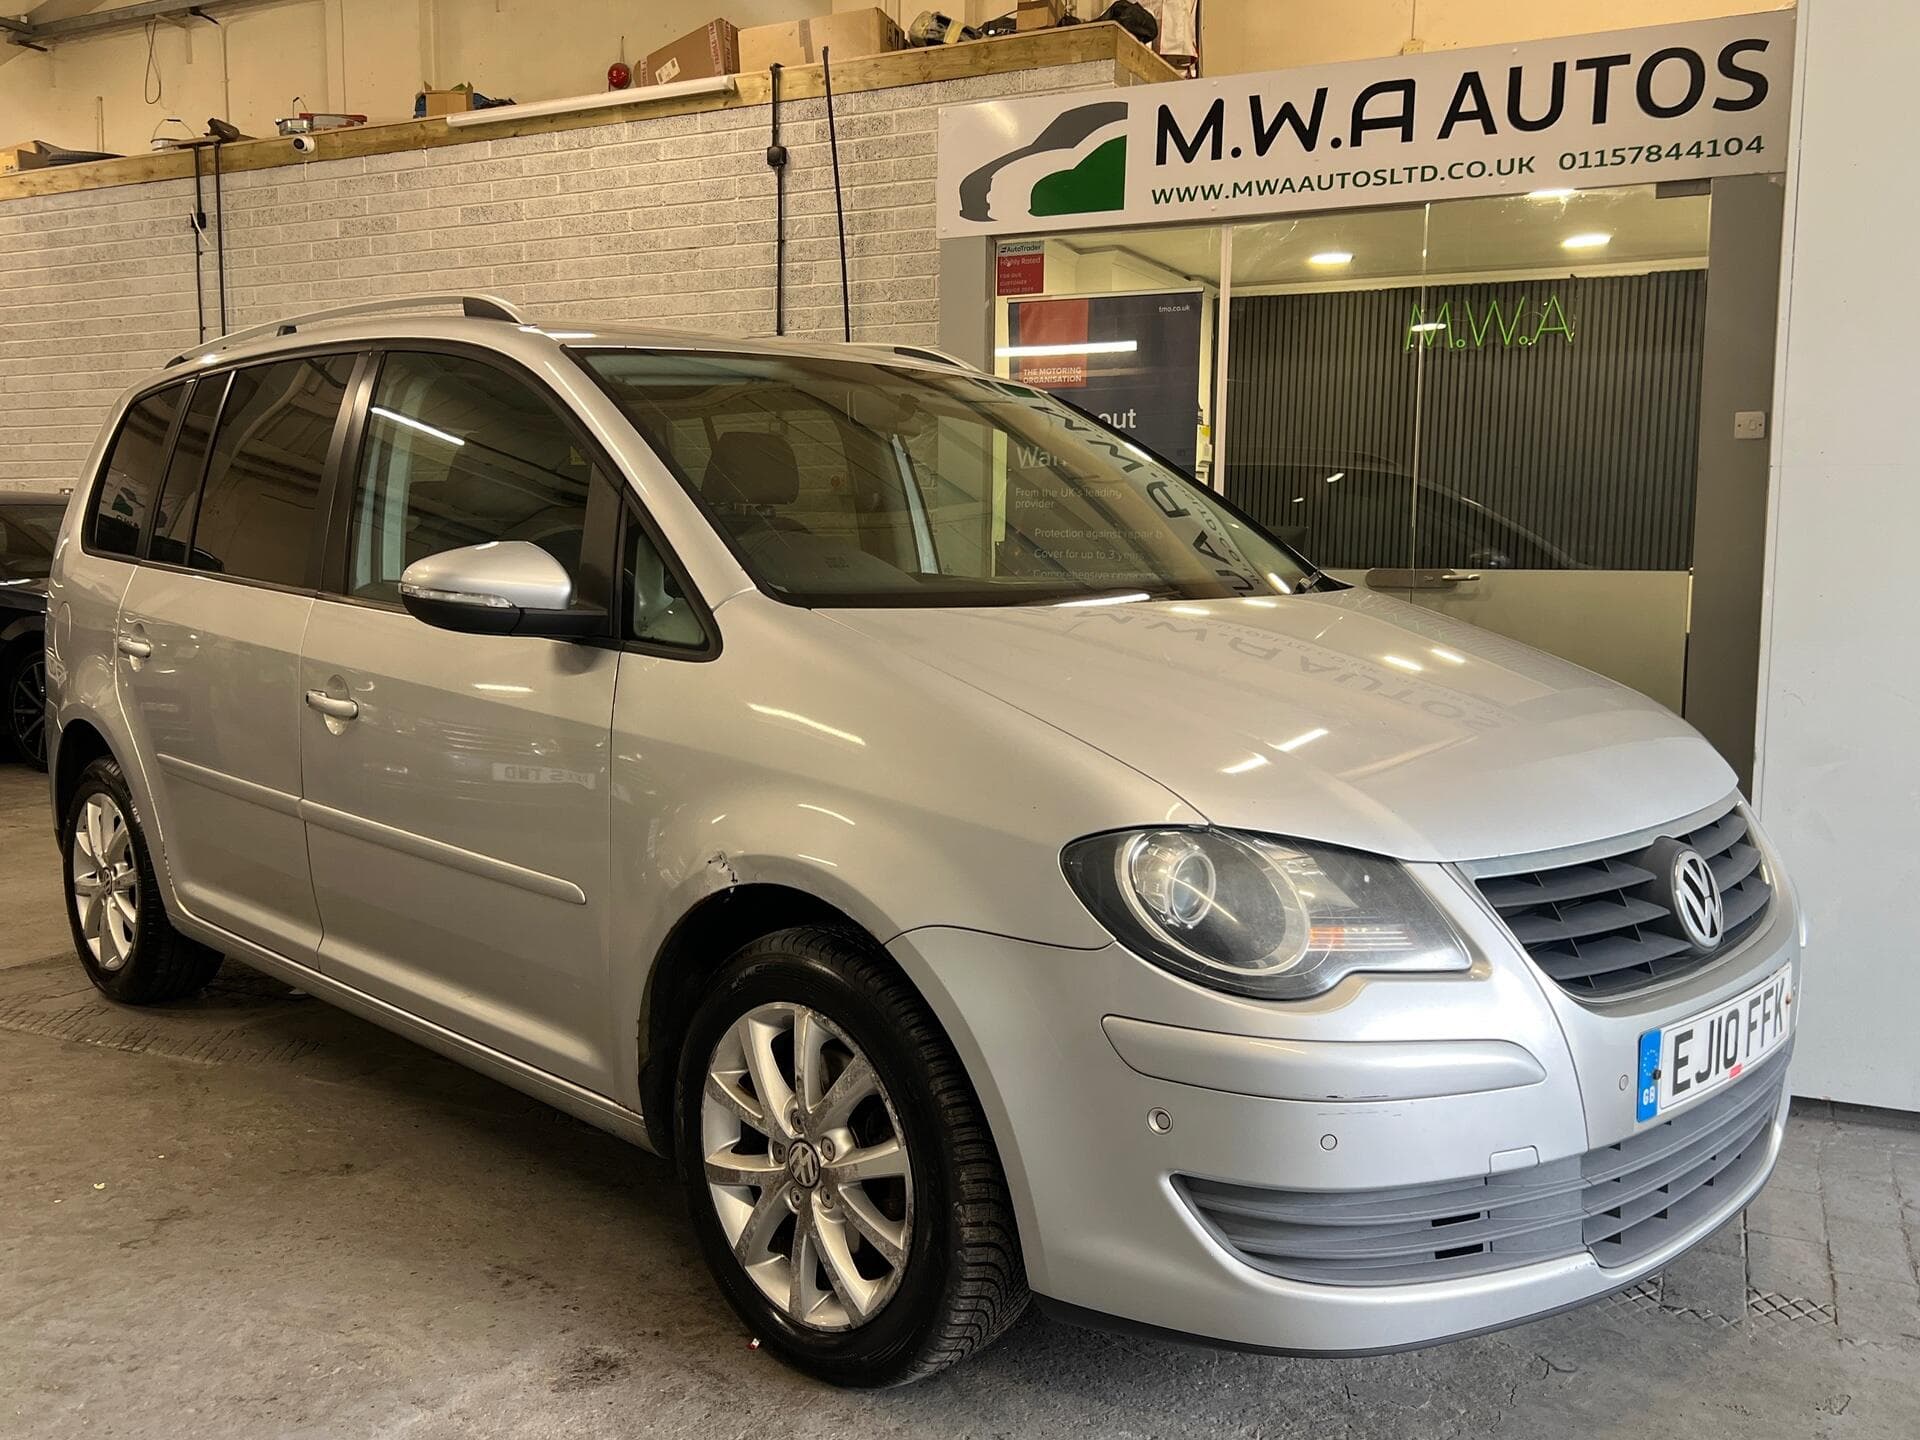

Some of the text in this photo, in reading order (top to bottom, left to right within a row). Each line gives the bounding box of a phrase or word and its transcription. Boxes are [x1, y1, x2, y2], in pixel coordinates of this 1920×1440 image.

[1155, 38, 1770, 166] M.W.A AUTOS
[1151, 135, 1765, 205] WWW.MWAAUTOSLTD.CO.UK 01157844104
[1158, 303, 1191, 313] tmo.co.uk
[1039, 367, 1082, 376] MOTORING
[1023, 375, 1082, 384] ORGANISATION
[1015, 488, 1039, 498] From
[1015, 500, 1054, 511] provider
[1034, 528, 1084, 538] Protection
[1034, 550, 1063, 559] Cover
[1066, 549, 1078, 559] for
[1081, 551, 1093, 561] up
[1096, 550, 1106, 559] to
[1671, 977, 1785, 1097] EJ10 FFK
[1642, 1085, 1656, 1106] GB
